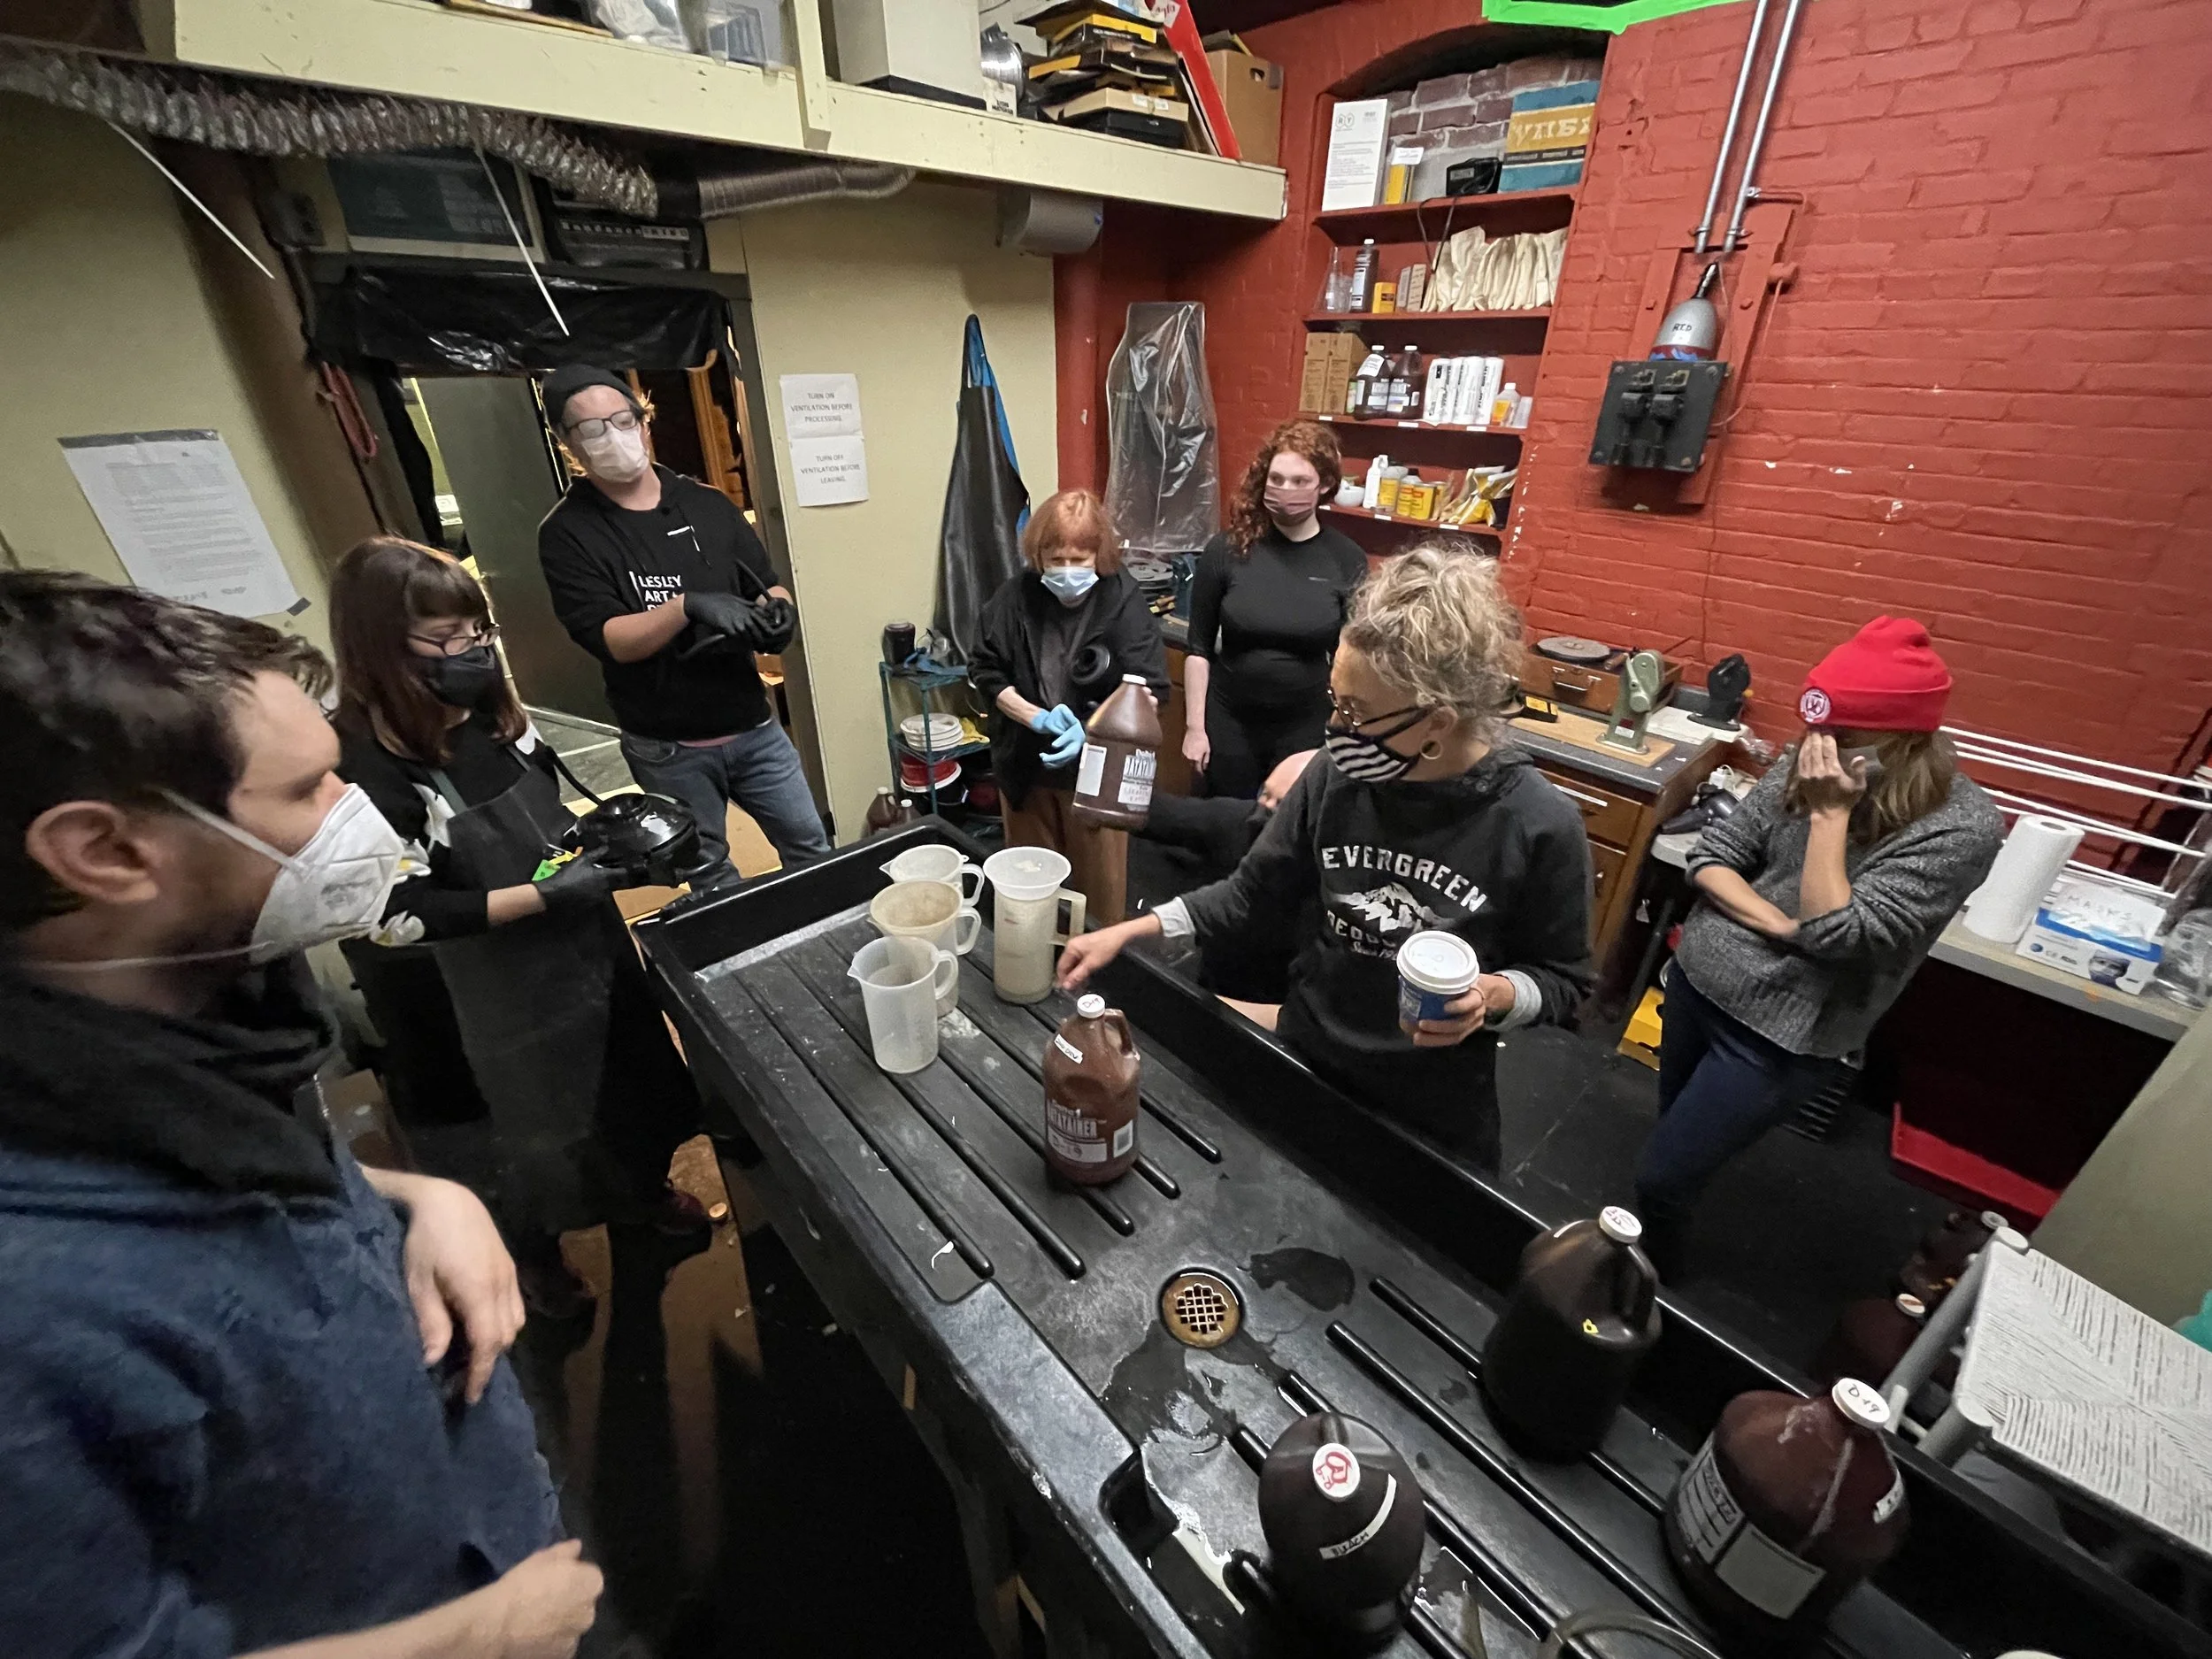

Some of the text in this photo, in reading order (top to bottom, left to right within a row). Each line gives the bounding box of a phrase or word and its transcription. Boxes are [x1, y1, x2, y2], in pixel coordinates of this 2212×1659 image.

[1671, 323, 1693, 332] RED
[638, 575, 681, 588] LESLEY
[645, 590, 669, 602] ART
[1321, 845, 1488, 912] EVERGREEN
